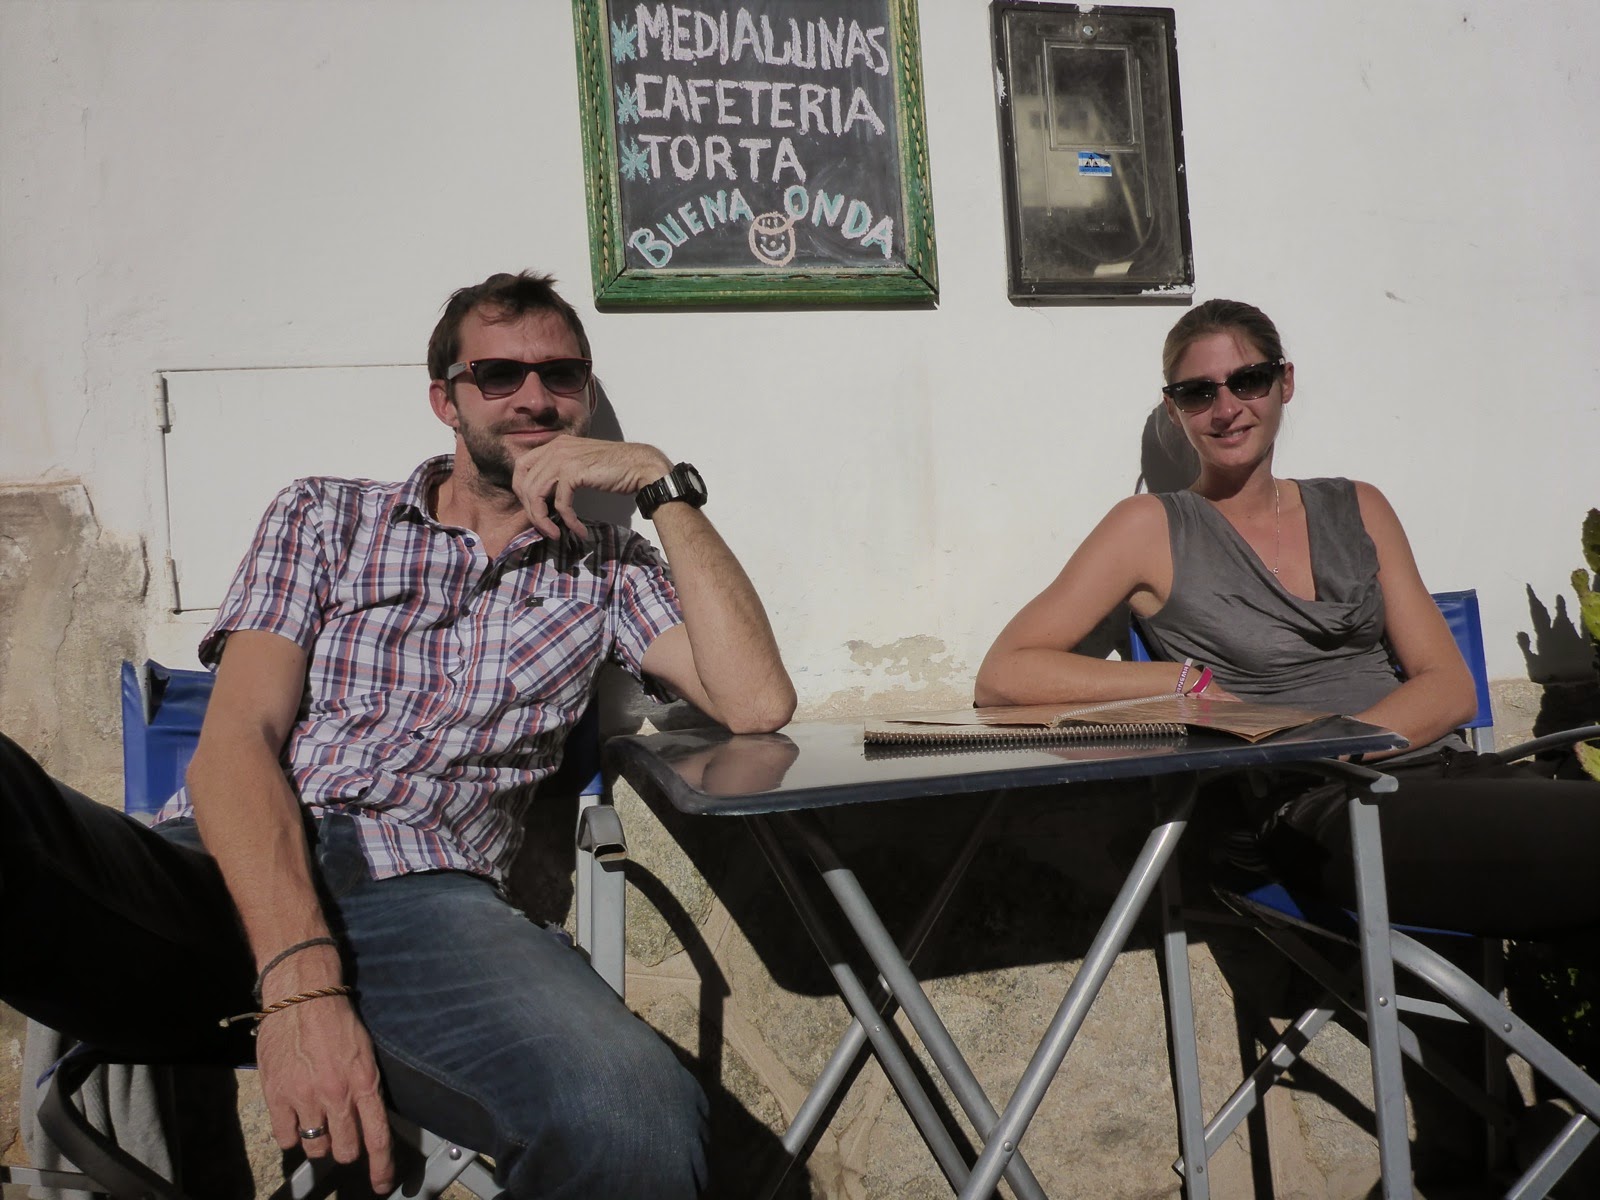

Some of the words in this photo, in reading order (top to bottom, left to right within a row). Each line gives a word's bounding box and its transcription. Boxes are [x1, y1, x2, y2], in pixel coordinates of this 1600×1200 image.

[635, 3, 890, 77] MEDIALUNAS
[635, 73, 886, 137] CAFETERIA
[637, 134, 807, 183] TORTA
[628, 188, 755, 268] BUENA
[783, 185, 894, 259] ONDA
